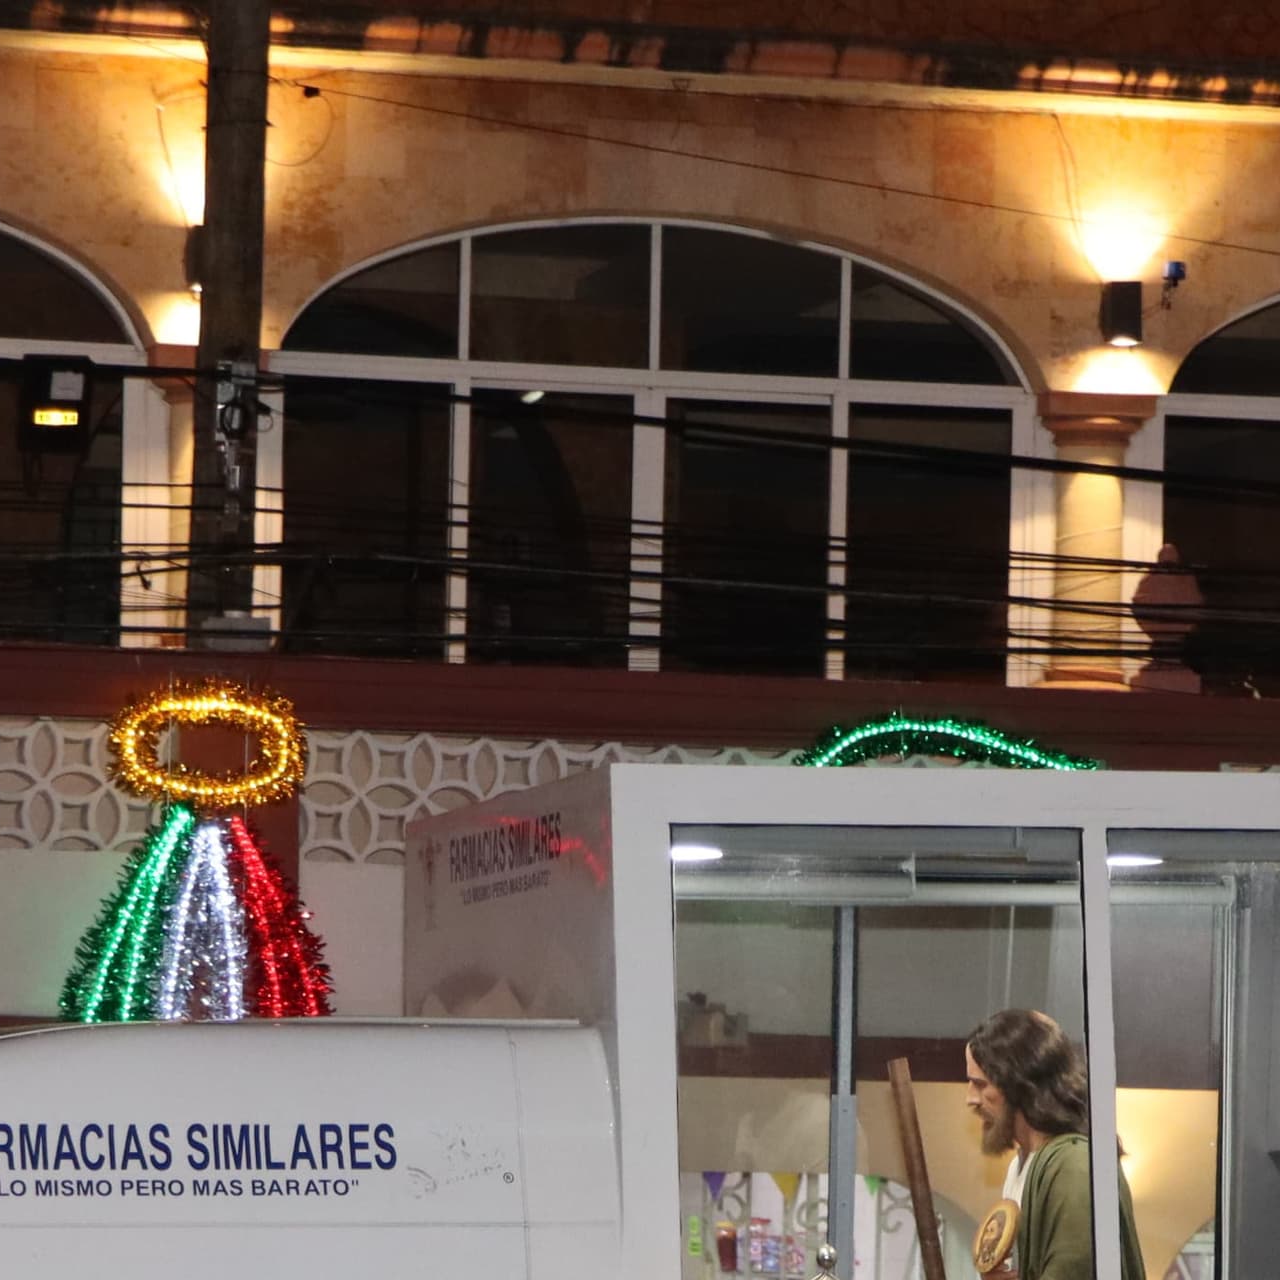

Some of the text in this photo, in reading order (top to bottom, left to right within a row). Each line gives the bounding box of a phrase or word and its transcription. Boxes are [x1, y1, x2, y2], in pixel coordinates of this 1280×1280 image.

[186, 1122, 399, 1172] SIMILARES
[34, 1179, 113, 1198] MISMO
[120, 1179, 185, 1198] PERO
[191, 1179, 245, 1198] MAS
[251, 1179, 360, 1198] BARATO"
